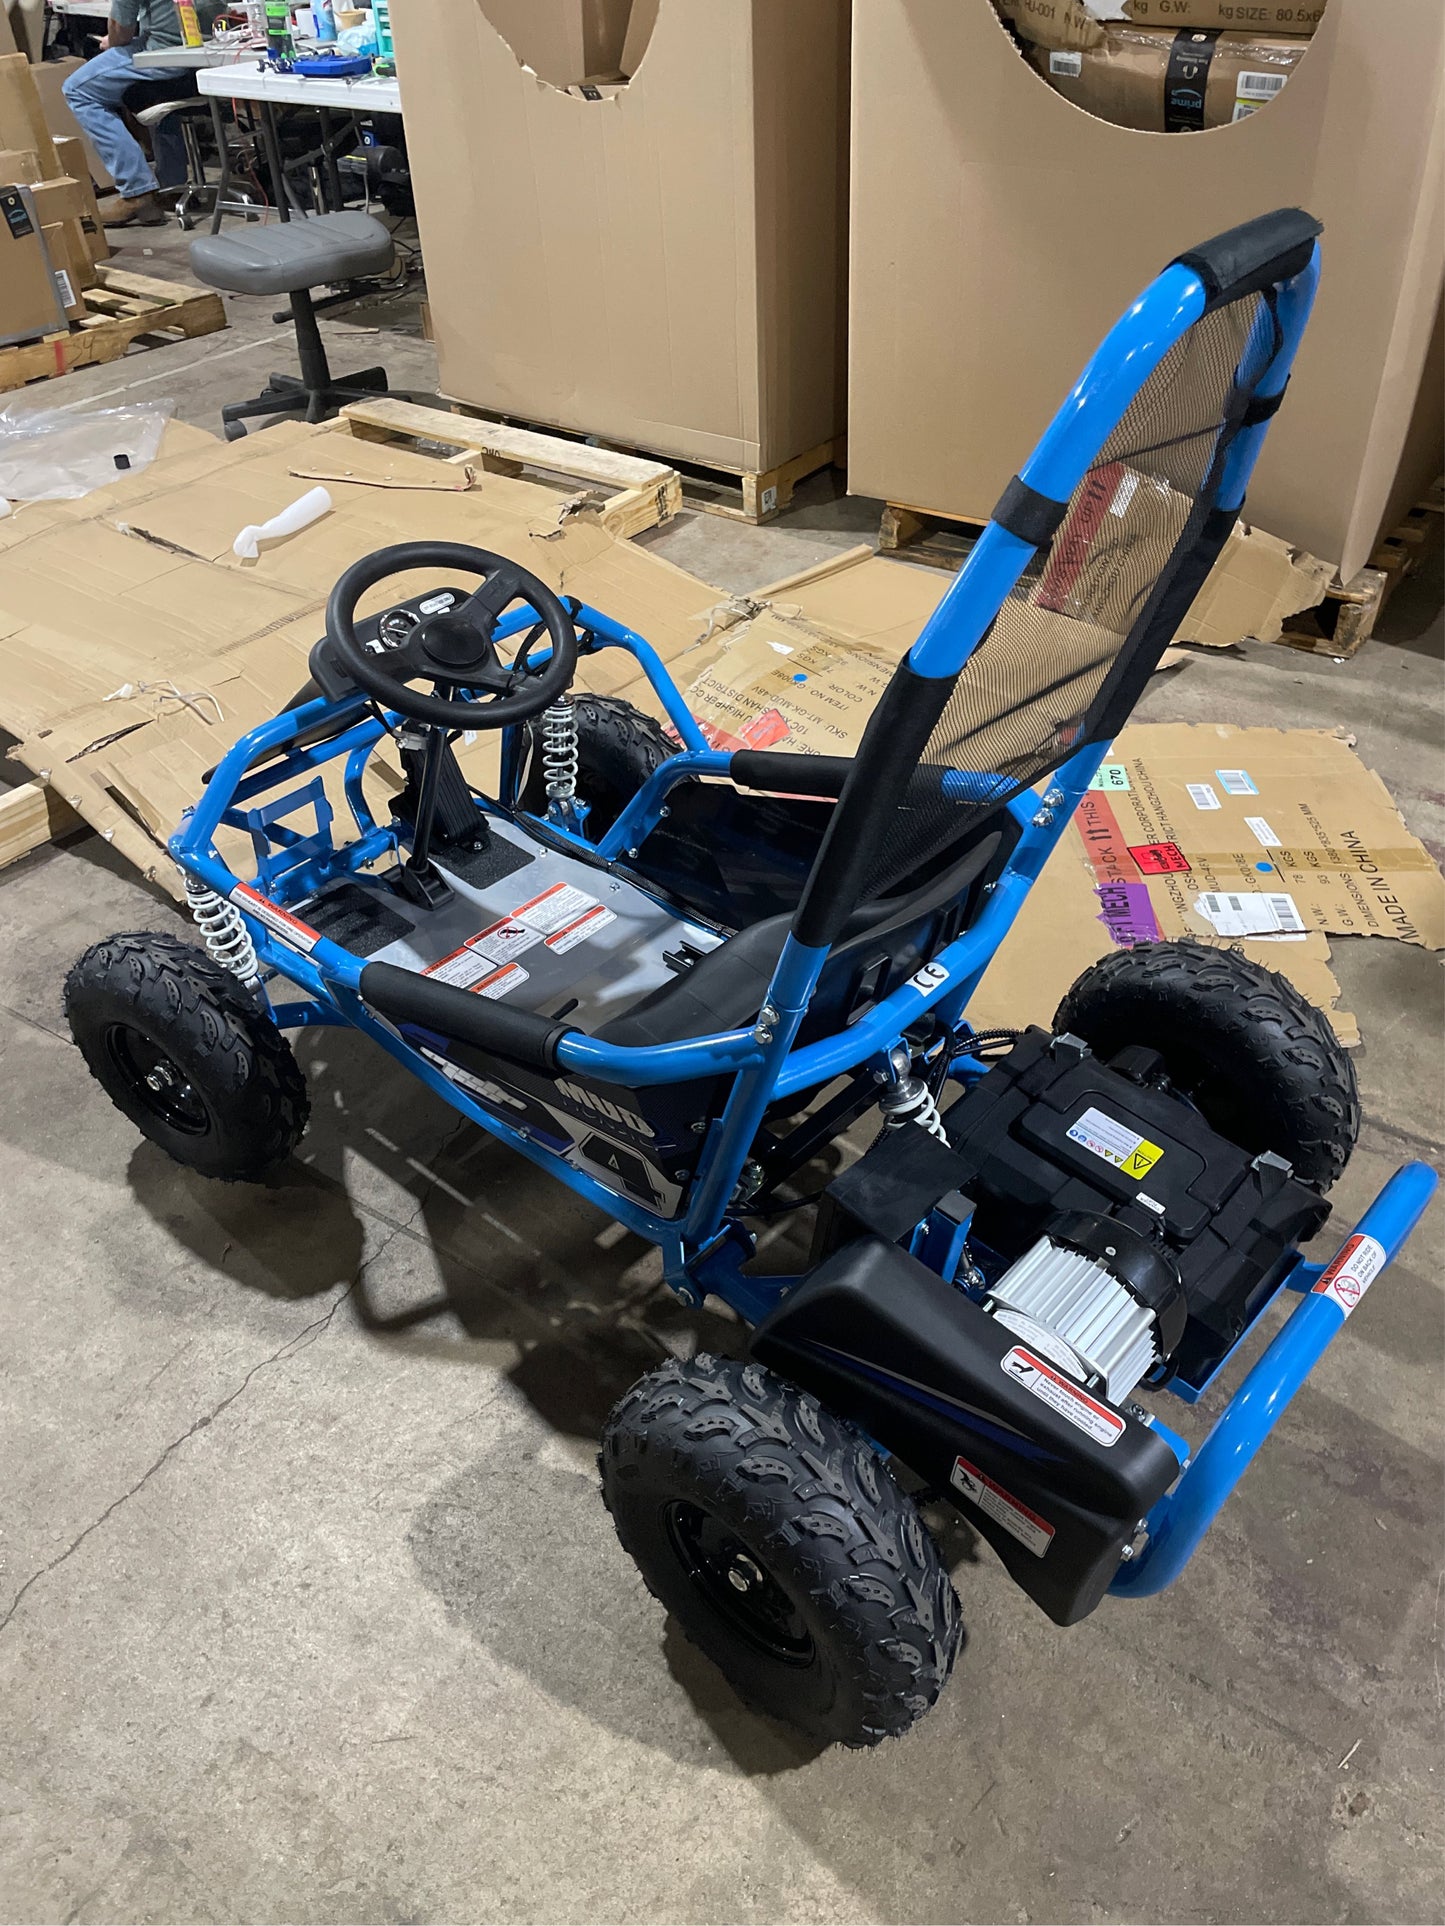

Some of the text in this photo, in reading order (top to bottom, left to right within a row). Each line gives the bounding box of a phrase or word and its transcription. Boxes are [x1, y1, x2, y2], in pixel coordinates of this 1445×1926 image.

[1133, 0, 1148, 13] kg
[1218, 4, 1233, 18] kg
[1170, 97, 1202, 109] prime
[796, 652, 817, 664] KGS
[822, 696, 849, 711] ITEM
[1109, 768, 1123, 784] 670
[1134, 757, 1148, 779] CHINA
[1144, 780, 1167, 821] HANGZHOU
[1299, 802, 1313, 815] MM
[1082, 801, 1101, 825] THIS
[1102, 846, 1126, 883] STACK
[1165, 845, 1185, 867] MECH
[1281, 850, 1297, 867] KGS
[1305, 850, 1321, 867] KGS
[1292, 874, 1306, 883] 78
[1317, 874, 1330, 884] 93
[1341, 829, 1419, 938] MADE IN CHINA
[267, 902, 297, 924] WARNING
[913, 965, 945, 988] CE
[553, 1078, 655, 1138] MUD
[1328, 1243, 1354, 1275] WARNING
[1351, 1245, 1373, 1272] DO NOT RIDE
[1358, 1251, 1378, 1278] ON BACK OF
[1036, 1387, 1048, 1396] until
[1047, 1395, 1059, 1406] they
[1060, 1405, 1073, 1416] have
[1043, 1378, 1058, 1390] Never
[1058, 1389, 1074, 1401] touch
[1073, 1401, 1091, 1415] engine
[1058, 1380, 1087, 1403] WARNING
[1039, 1382, 1111, 1437] exhaust after running engine
